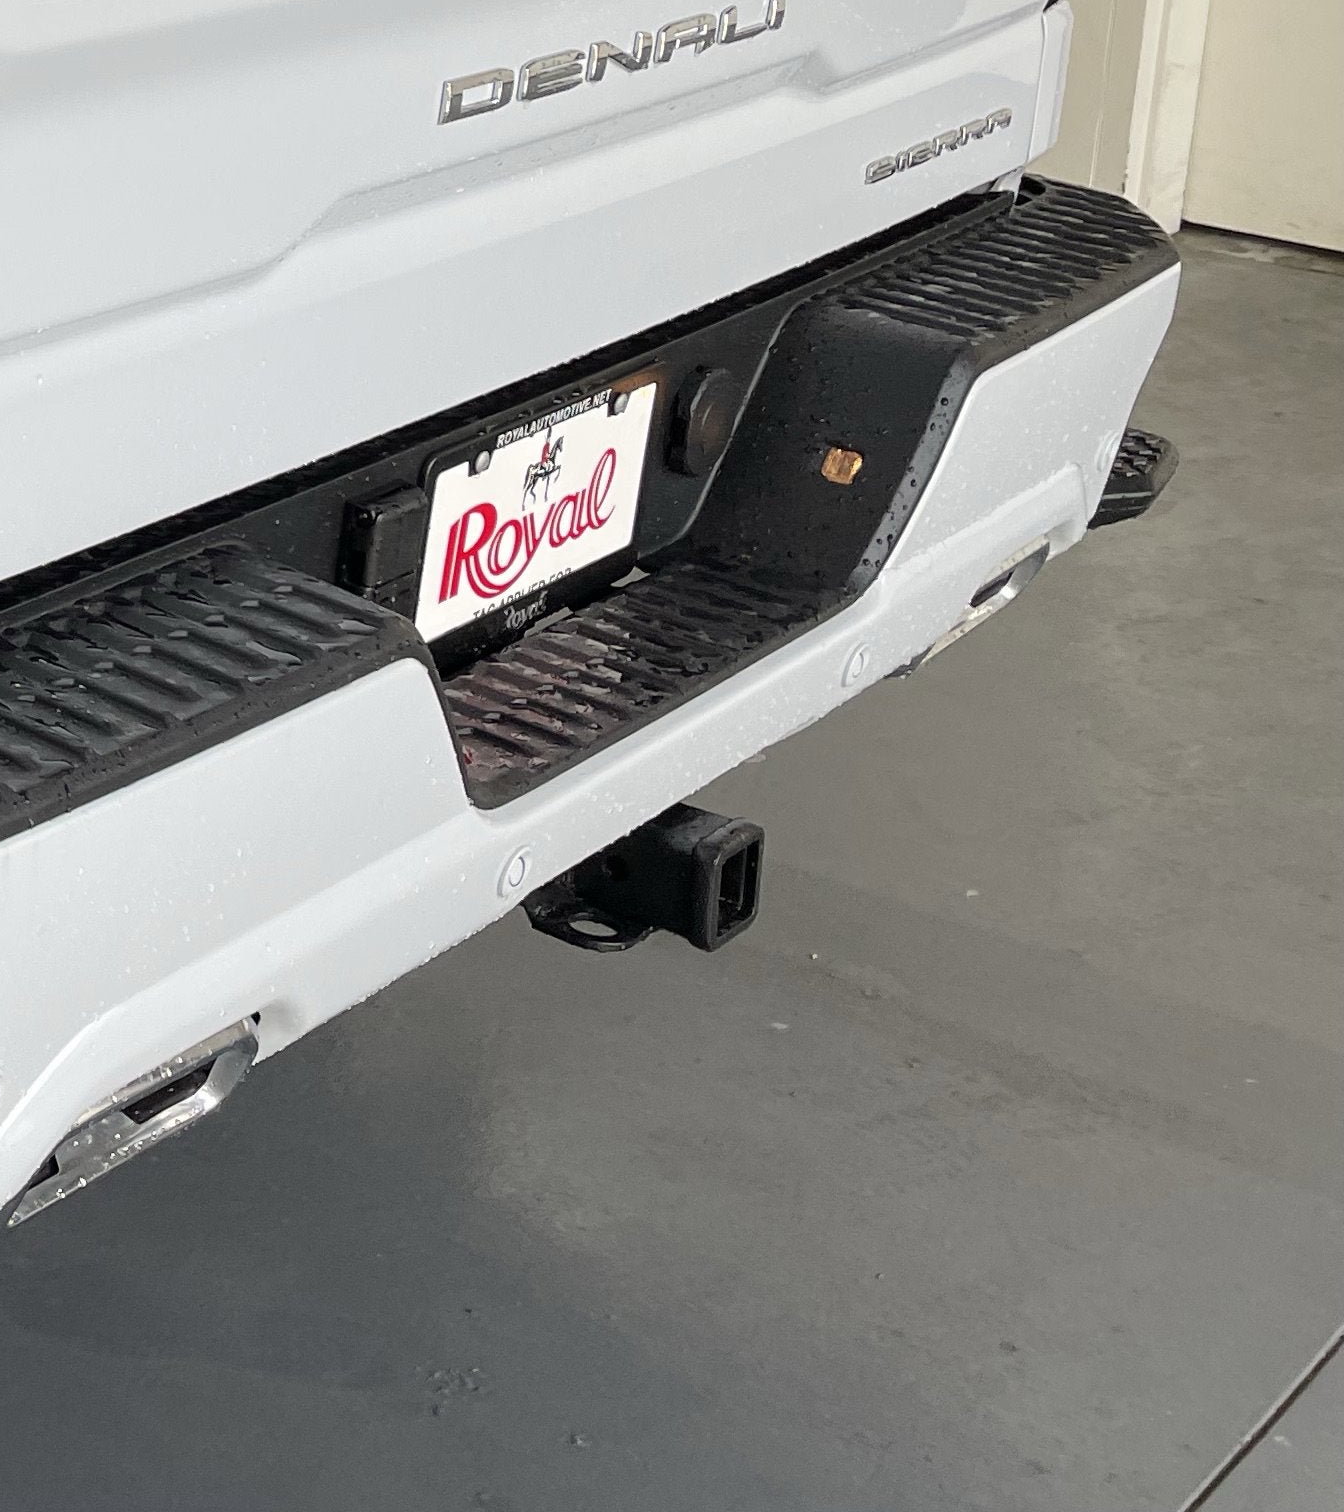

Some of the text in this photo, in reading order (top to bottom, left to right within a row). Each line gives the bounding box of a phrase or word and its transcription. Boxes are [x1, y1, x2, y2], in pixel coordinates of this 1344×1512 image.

[864, 107, 1013, 185] SIERRA
[496, 388, 613, 450] ROYALAUTOMOTIVE.NET
[438, 447, 617, 605] Royal
